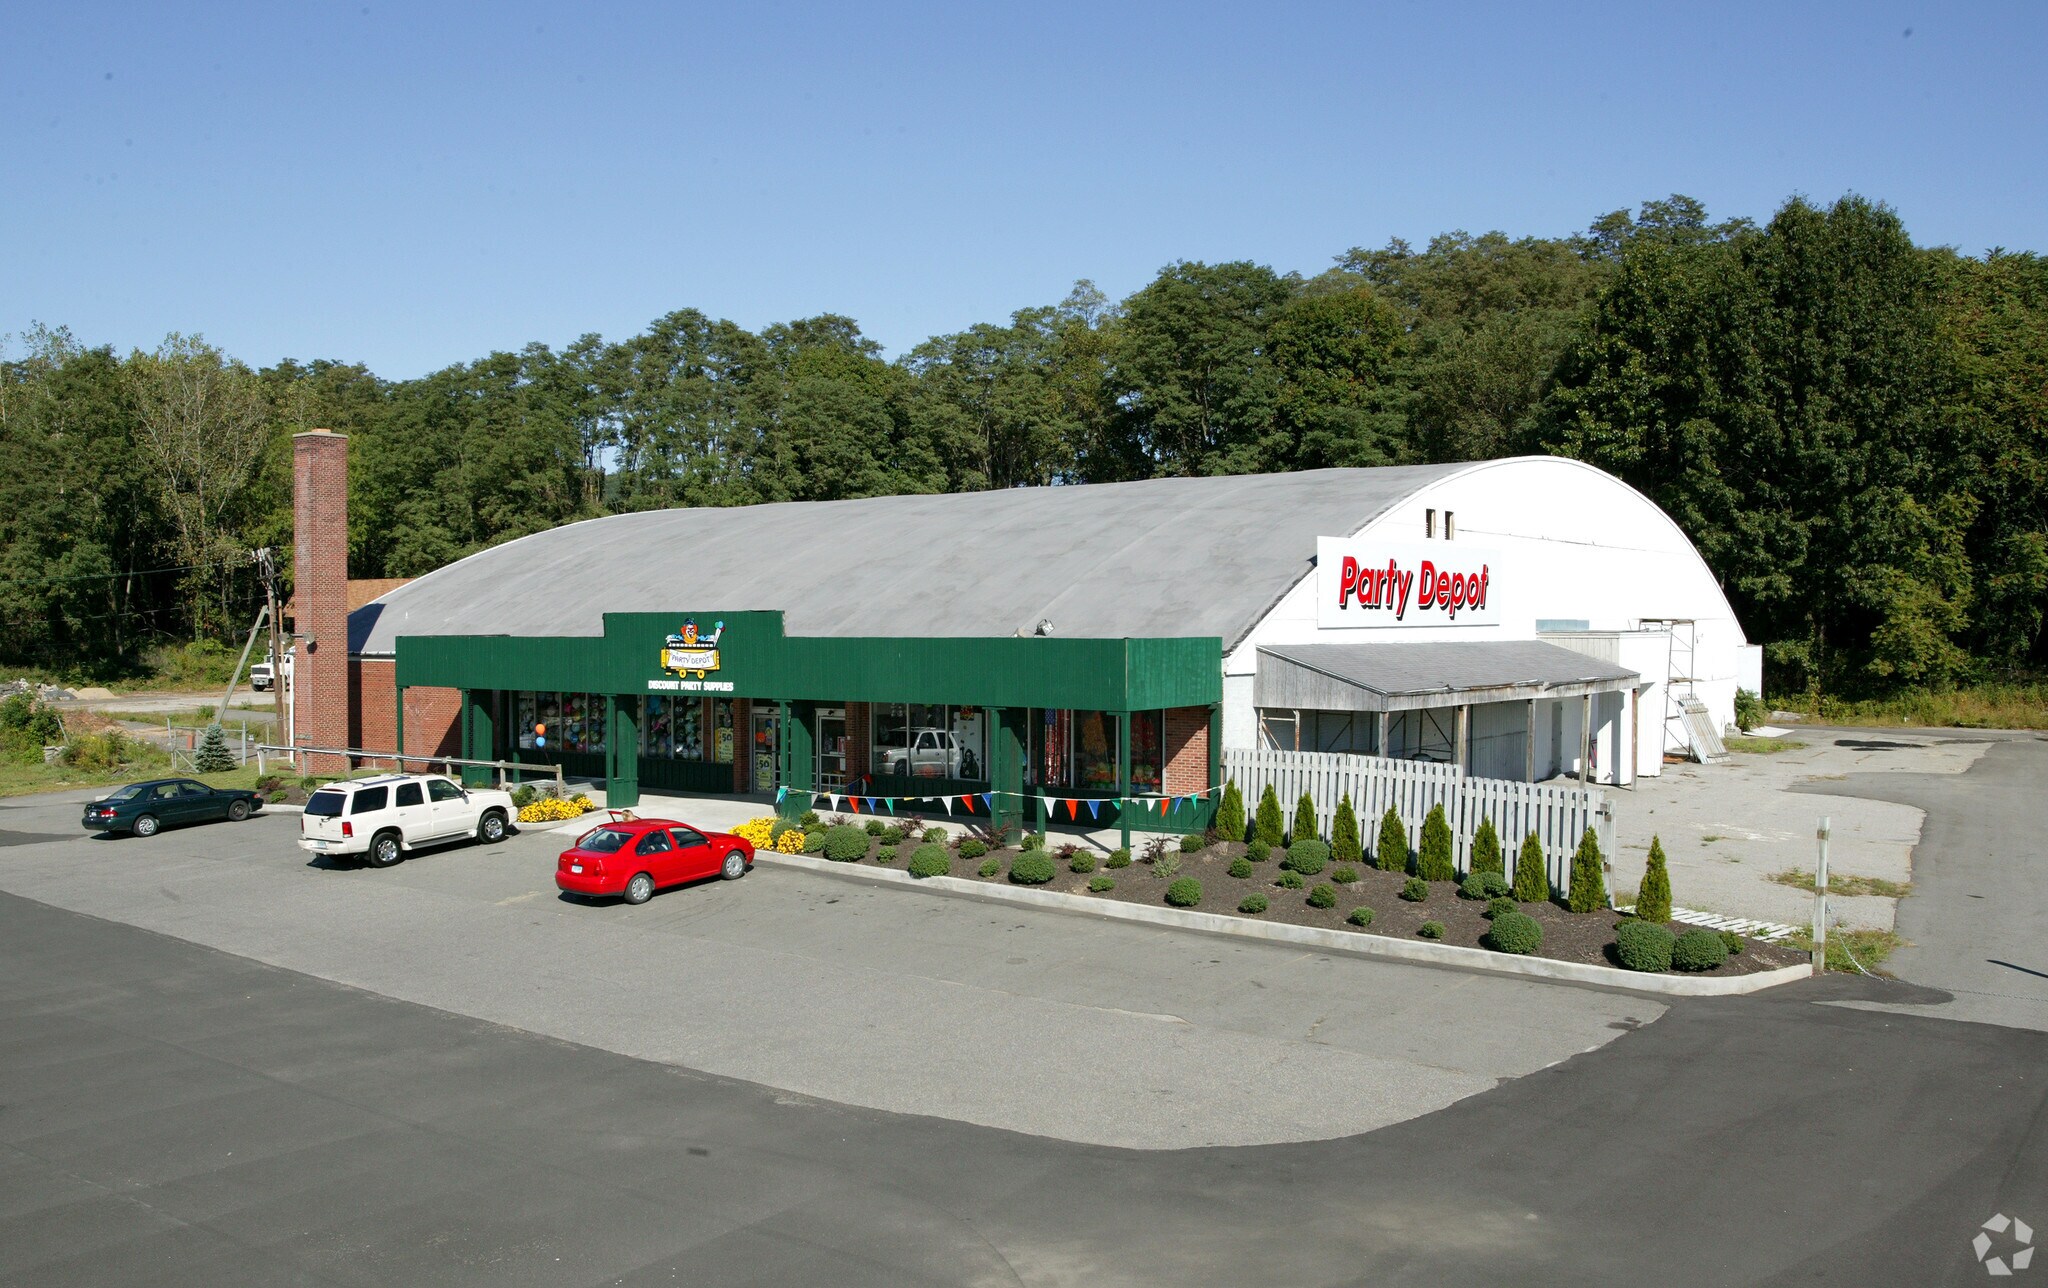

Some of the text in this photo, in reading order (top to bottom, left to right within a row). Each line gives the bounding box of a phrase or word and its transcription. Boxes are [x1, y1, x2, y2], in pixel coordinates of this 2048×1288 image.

[1339, 556, 1488, 621] Party Depot
[671, 654, 710, 664] PARTY DEPOT
[648, 680, 734, 691] DISCOUNT PARTY SUPPLIES
